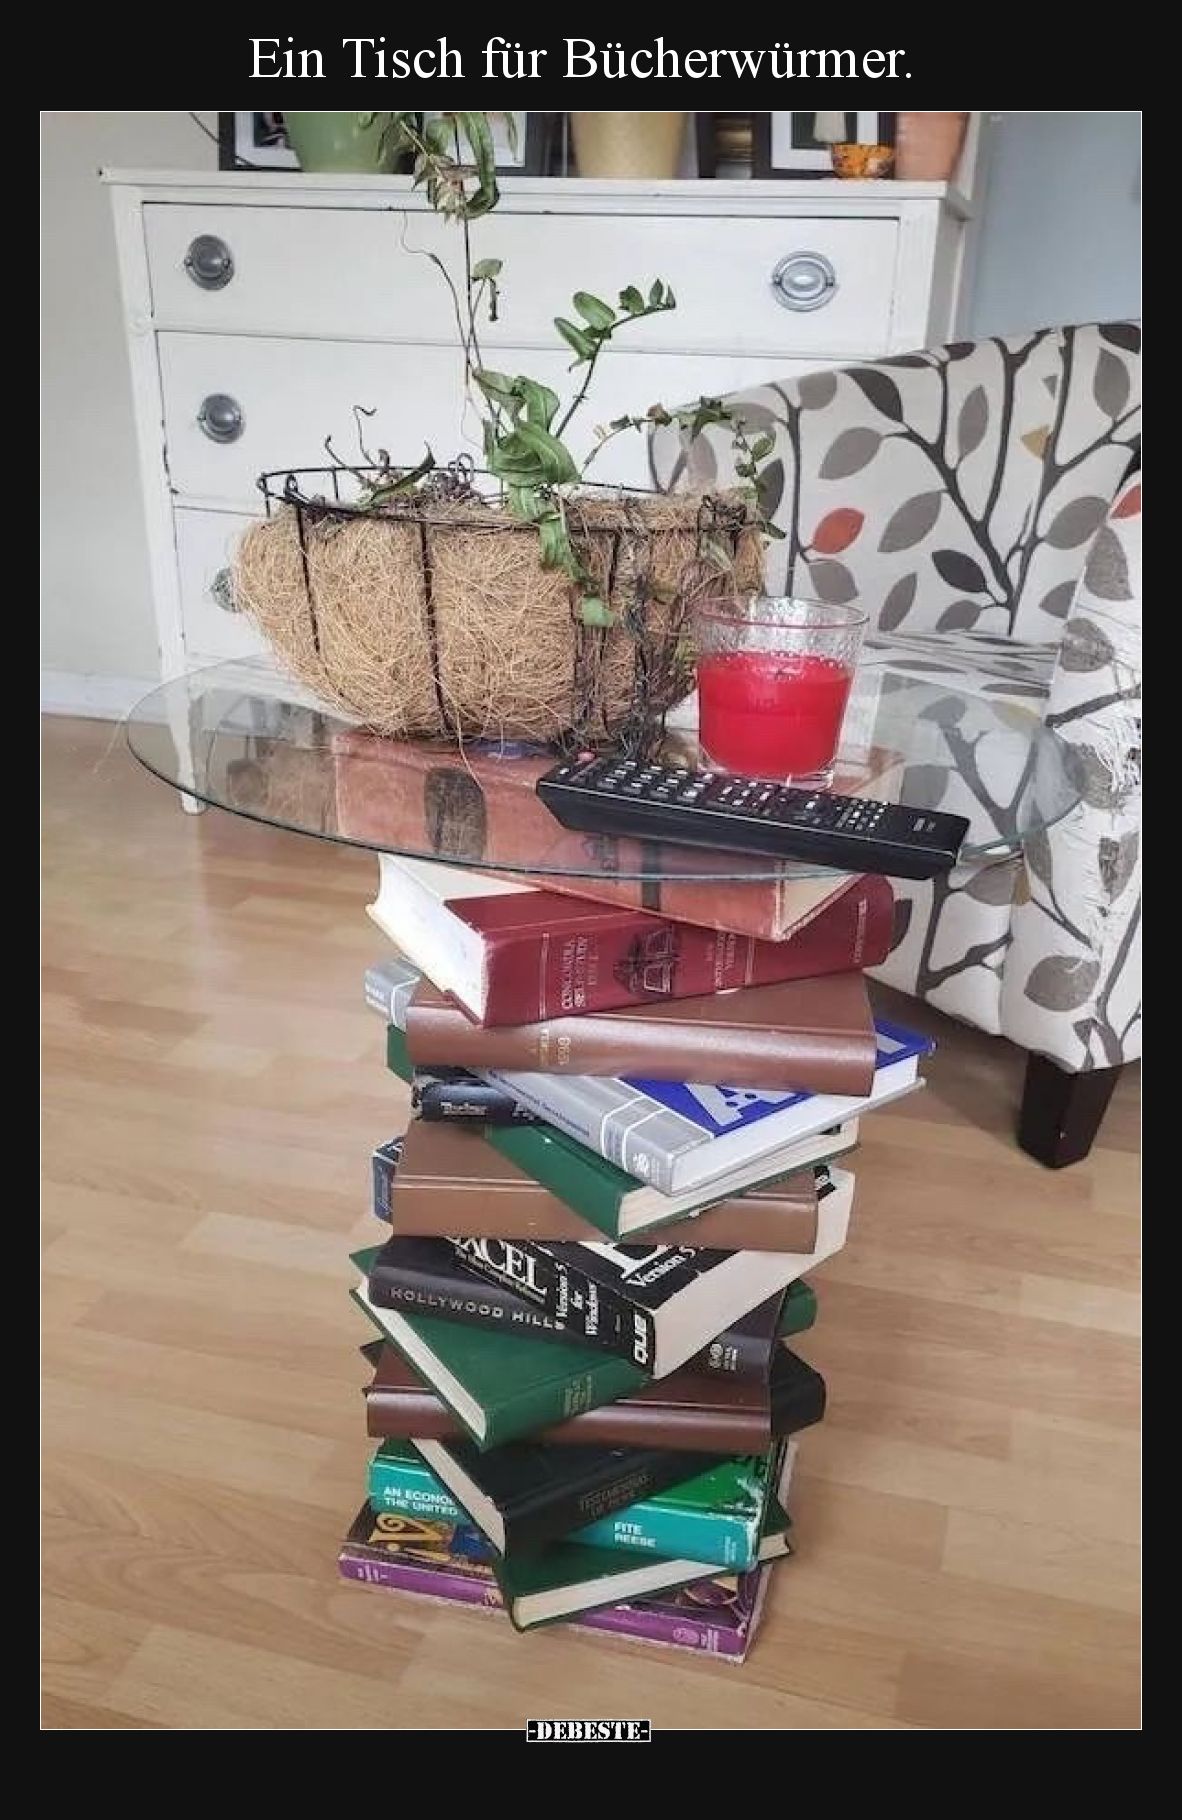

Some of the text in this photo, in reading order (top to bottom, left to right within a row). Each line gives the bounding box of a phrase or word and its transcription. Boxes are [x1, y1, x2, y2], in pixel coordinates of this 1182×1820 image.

[625, 1255, 687, 1287] Version
[390, 1286, 566, 1331] HOLLYWOOD HILLS
[633, 1310, 649, 1365] QUE
[384, 1486, 401, 1499] AN
[384, 1497, 458, 1516] THE UNITED
[613, 1521, 643, 1536] FITE
[613, 1532, 657, 1549] REESE
